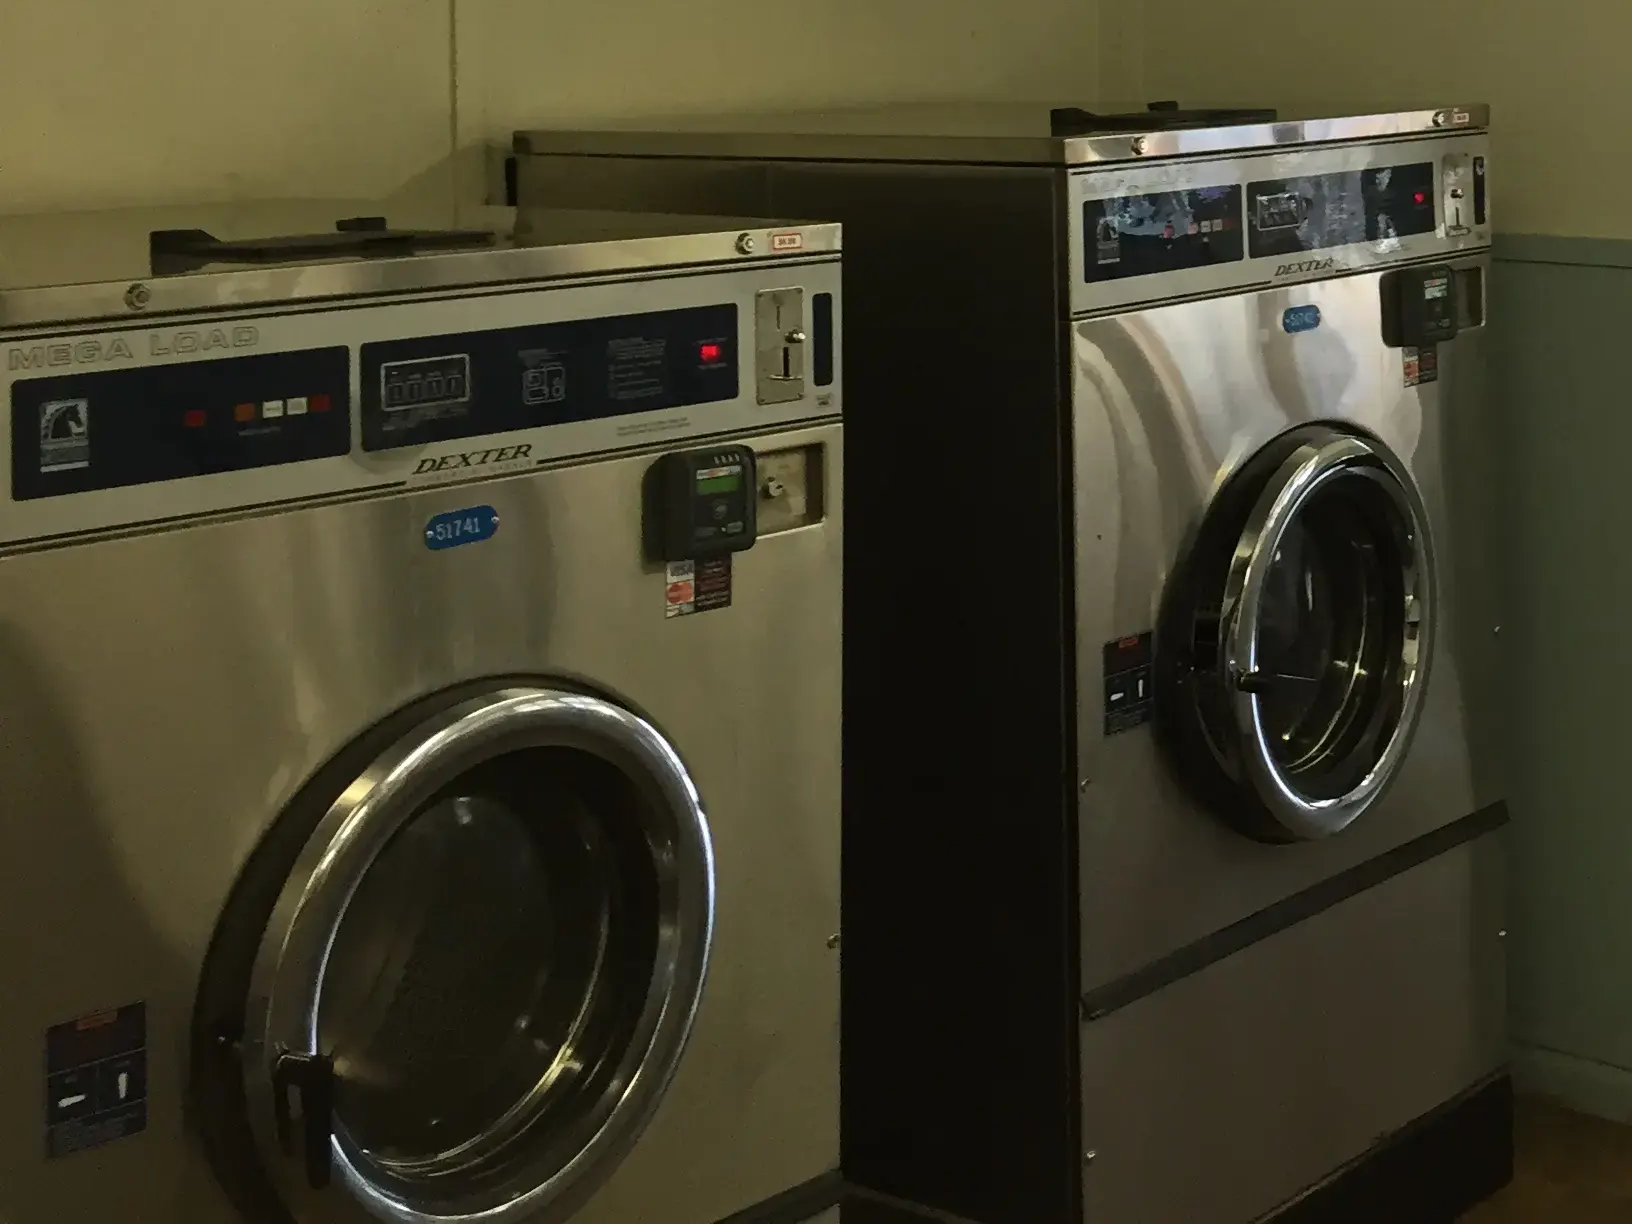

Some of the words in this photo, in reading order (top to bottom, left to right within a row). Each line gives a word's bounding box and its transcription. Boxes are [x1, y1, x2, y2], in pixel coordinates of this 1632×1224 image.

[1273, 257, 1334, 277] DEXTER
[8, 337, 134, 371] MEGA
[150, 326, 260, 356] LOAD
[411, 443, 533, 475] DEXTER
[435, 517, 481, 541] 51741
